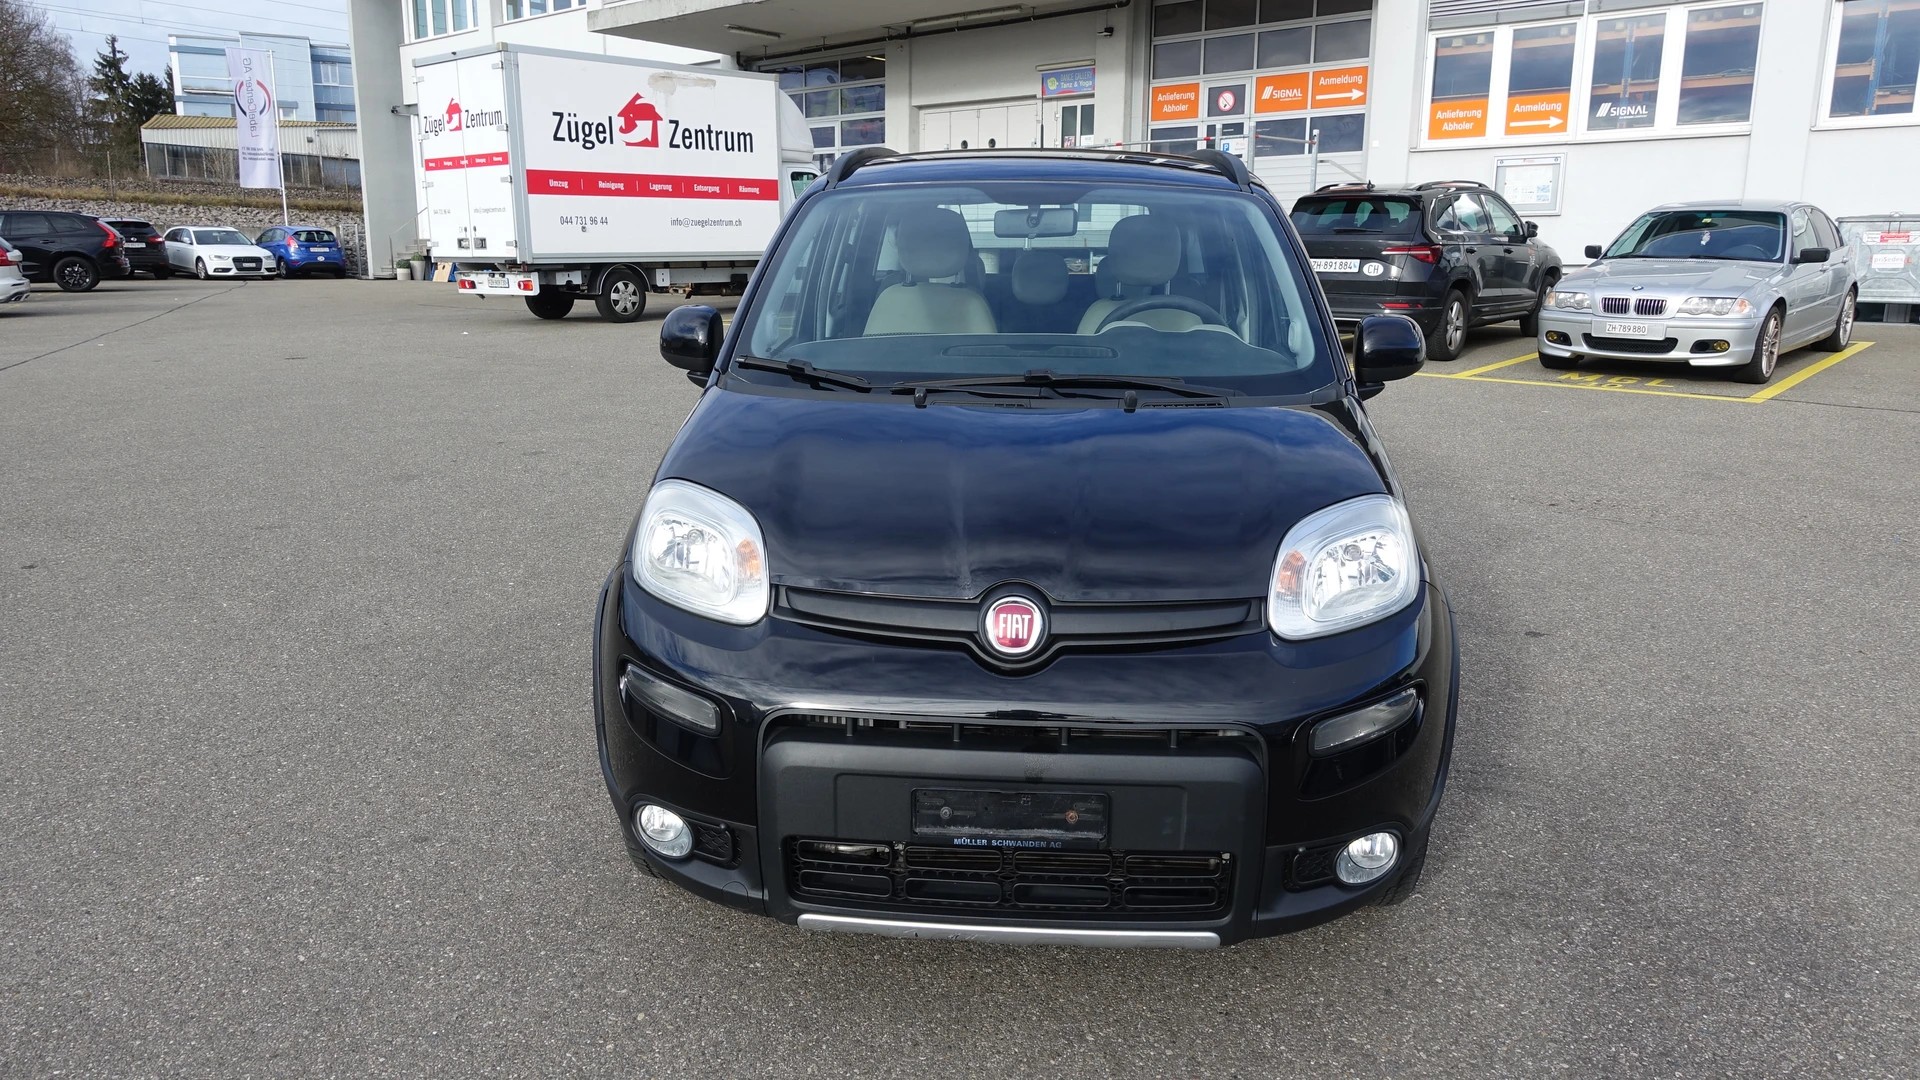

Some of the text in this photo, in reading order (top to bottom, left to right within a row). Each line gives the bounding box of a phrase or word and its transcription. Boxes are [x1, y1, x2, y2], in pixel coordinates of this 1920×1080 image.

[1079, 80, 1092, 88] Yoga
[1319, 74, 1363, 86] Anmeldung
[1157, 91, 1195, 102] Anlieferung
[1272, 88, 1302, 98] SIGNAL
[1162, 103, 1189, 113] Abholer
[1513, 101, 1562, 113] Anmeldung
[1610, 105, 1649, 117] SIGNAL
[1436, 109, 1482, 120] Anlieferung
[424, 109, 502, 136] Zügel Zentrum
[1442, 121, 1474, 131] Abholer
[552, 112, 754, 153] Zügel Zentrum
[549, 179, 569, 189] Umzug
[598, 181, 625, 190] Reinigung
[649, 183, 672, 191] Lagerung
[694, 184, 720, 193] Entsorgung
[739, 185, 760, 194] Räumung
[560, 216, 608, 225] 044 731 96 44
[670, 217, 742, 228] info@zuegelzentrum.ch
[1367, 264, 1379, 274] CH
[998, 613, 1031, 639] FIAT
[953, 837, 1062, 849] MÜLLER SCHWANDEN AG
